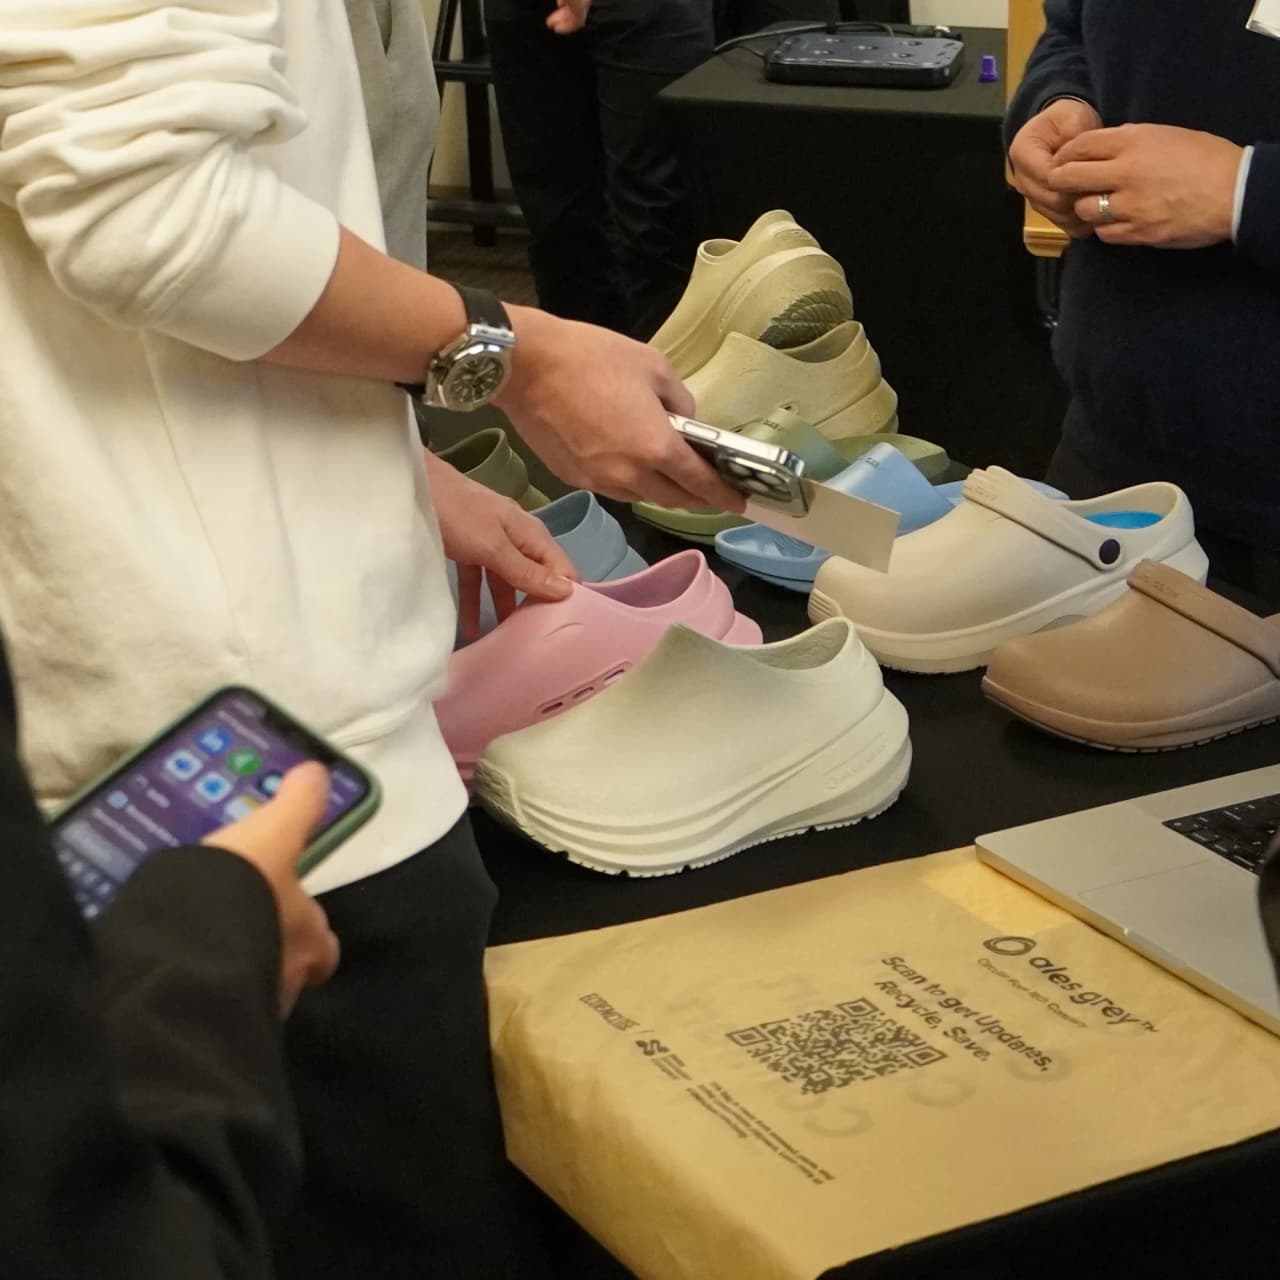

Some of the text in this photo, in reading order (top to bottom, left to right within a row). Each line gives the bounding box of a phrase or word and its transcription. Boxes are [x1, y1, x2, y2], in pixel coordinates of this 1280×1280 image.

[881, 955, 927, 985] Scan
[923, 981, 948, 997] to
[938, 996, 979, 1019] get
[1028, 956, 1084, 991] ales
